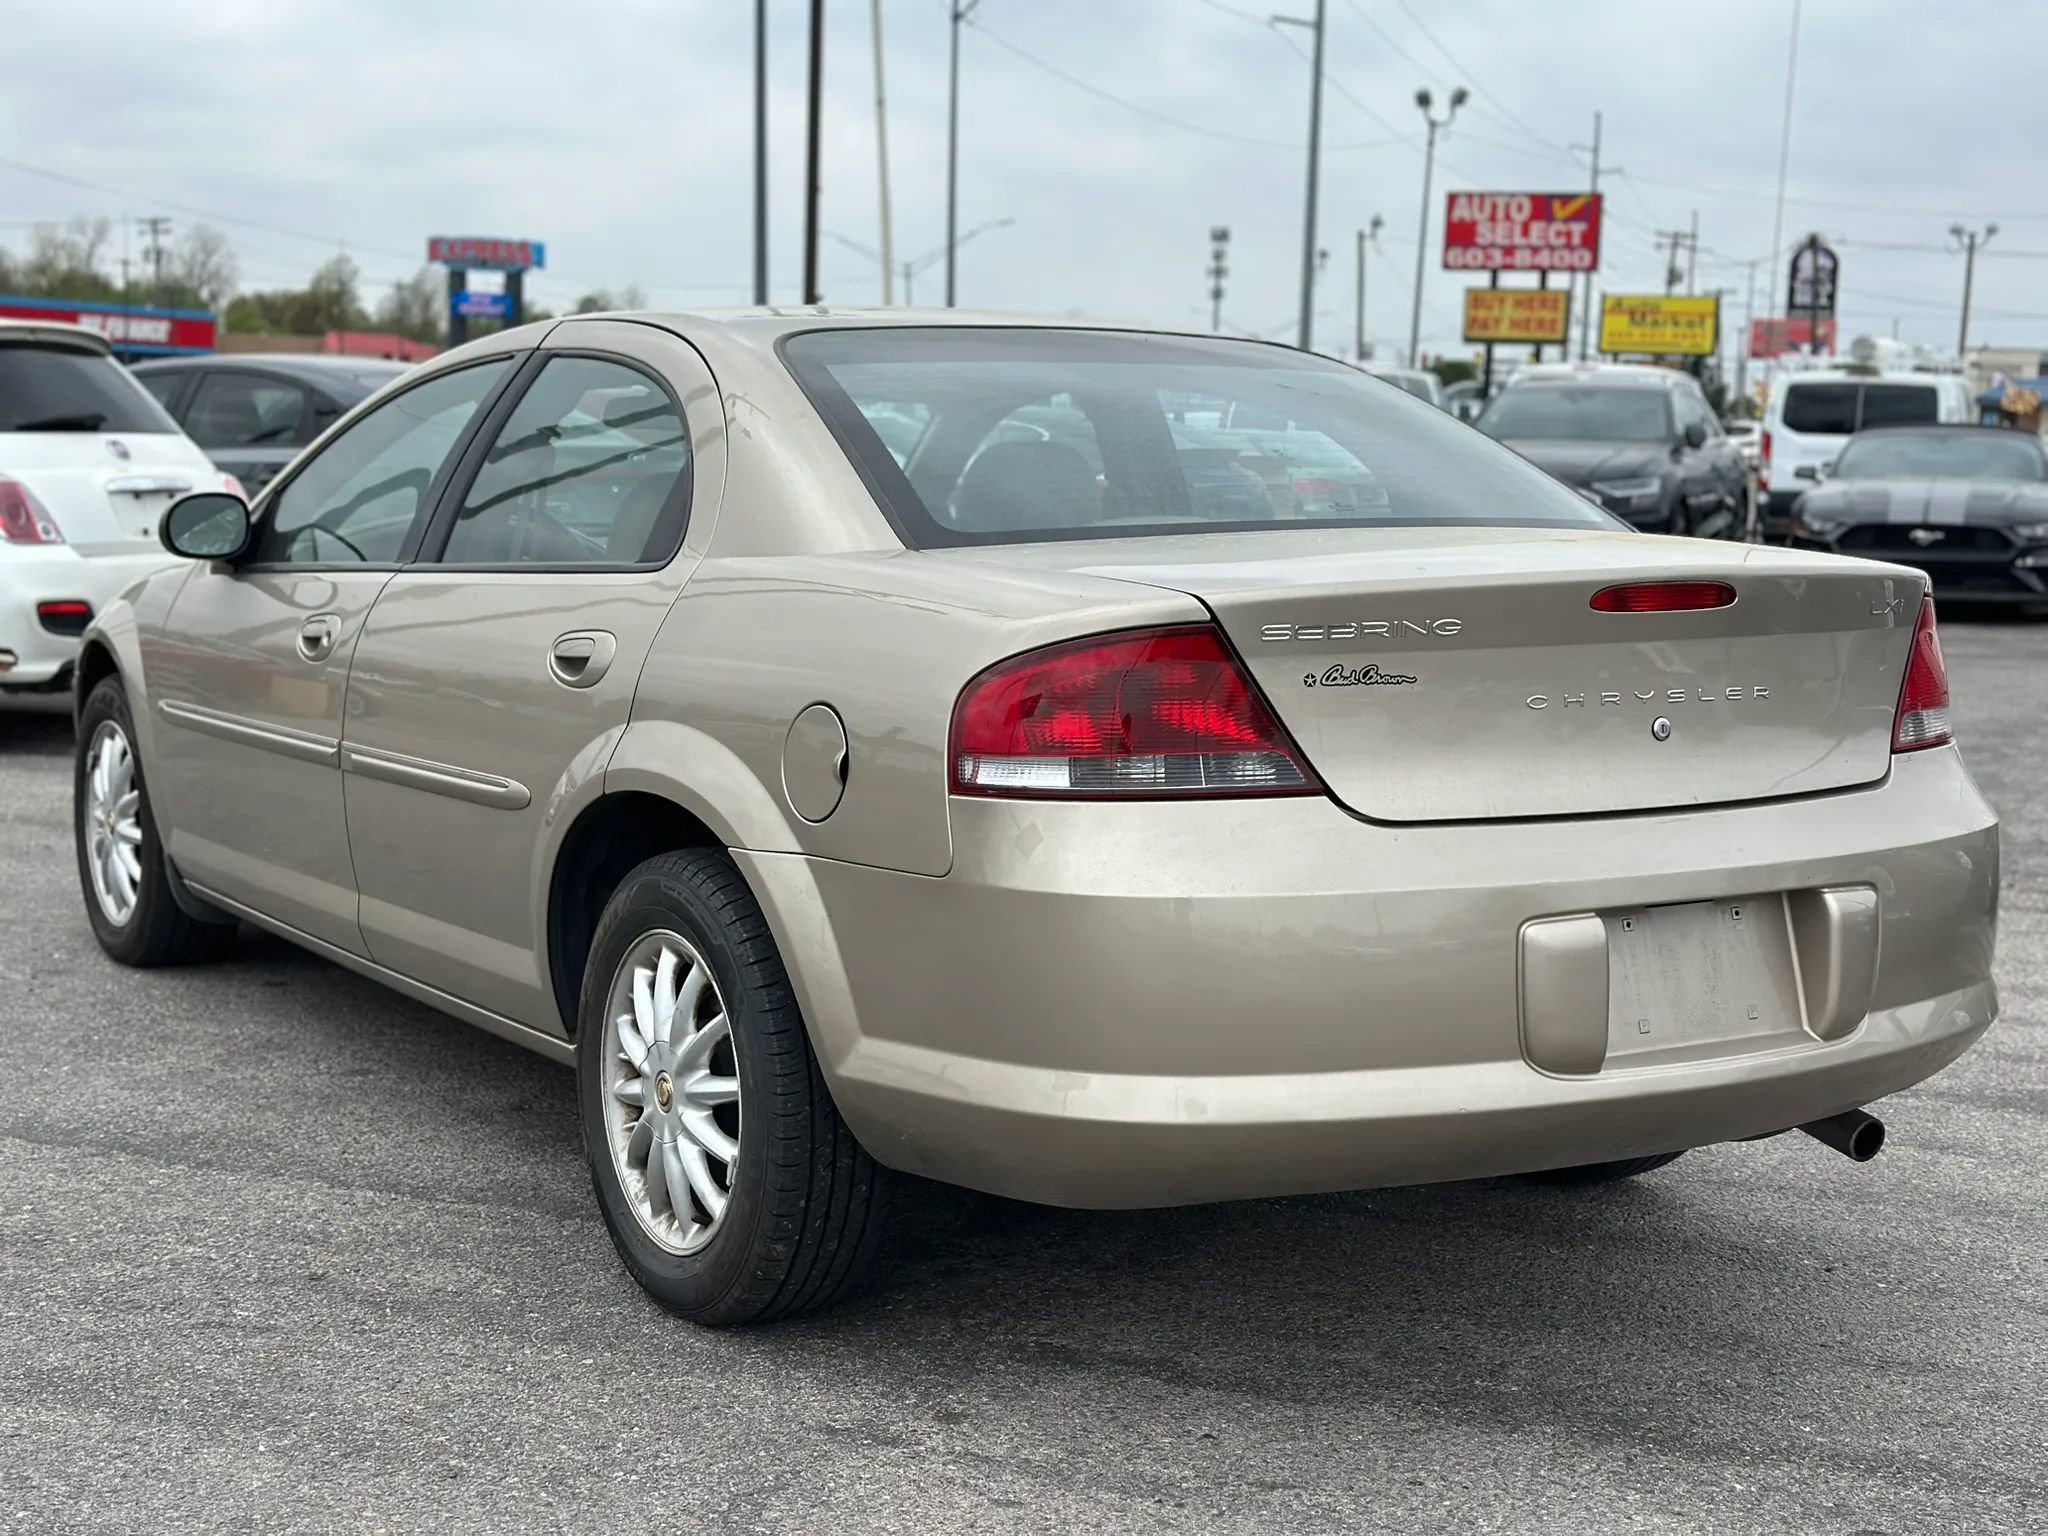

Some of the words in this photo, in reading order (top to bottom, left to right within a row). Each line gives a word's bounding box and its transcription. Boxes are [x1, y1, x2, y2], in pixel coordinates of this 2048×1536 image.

[1451, 195, 1532, 222] AUTO
[1474, 220, 1588, 247] SELECT
[1445, 246, 1593, 268] 603-8400
[1470, 293, 1504, 311] BUY
[1511, 294, 1561, 312] HERE
[1609, 297, 1662, 313] Auto
[1468, 315, 1501, 333] PAY
[1508, 316, 1559, 334] HERE
[1628, 311, 1706, 330] Market
[1260, 618, 1463, 642] SEBRING
[1320, 663, 1359, 687] Bud
[1358, 663, 1418, 687] Brown
[1526, 685, 1770, 711] CHRYSLER
